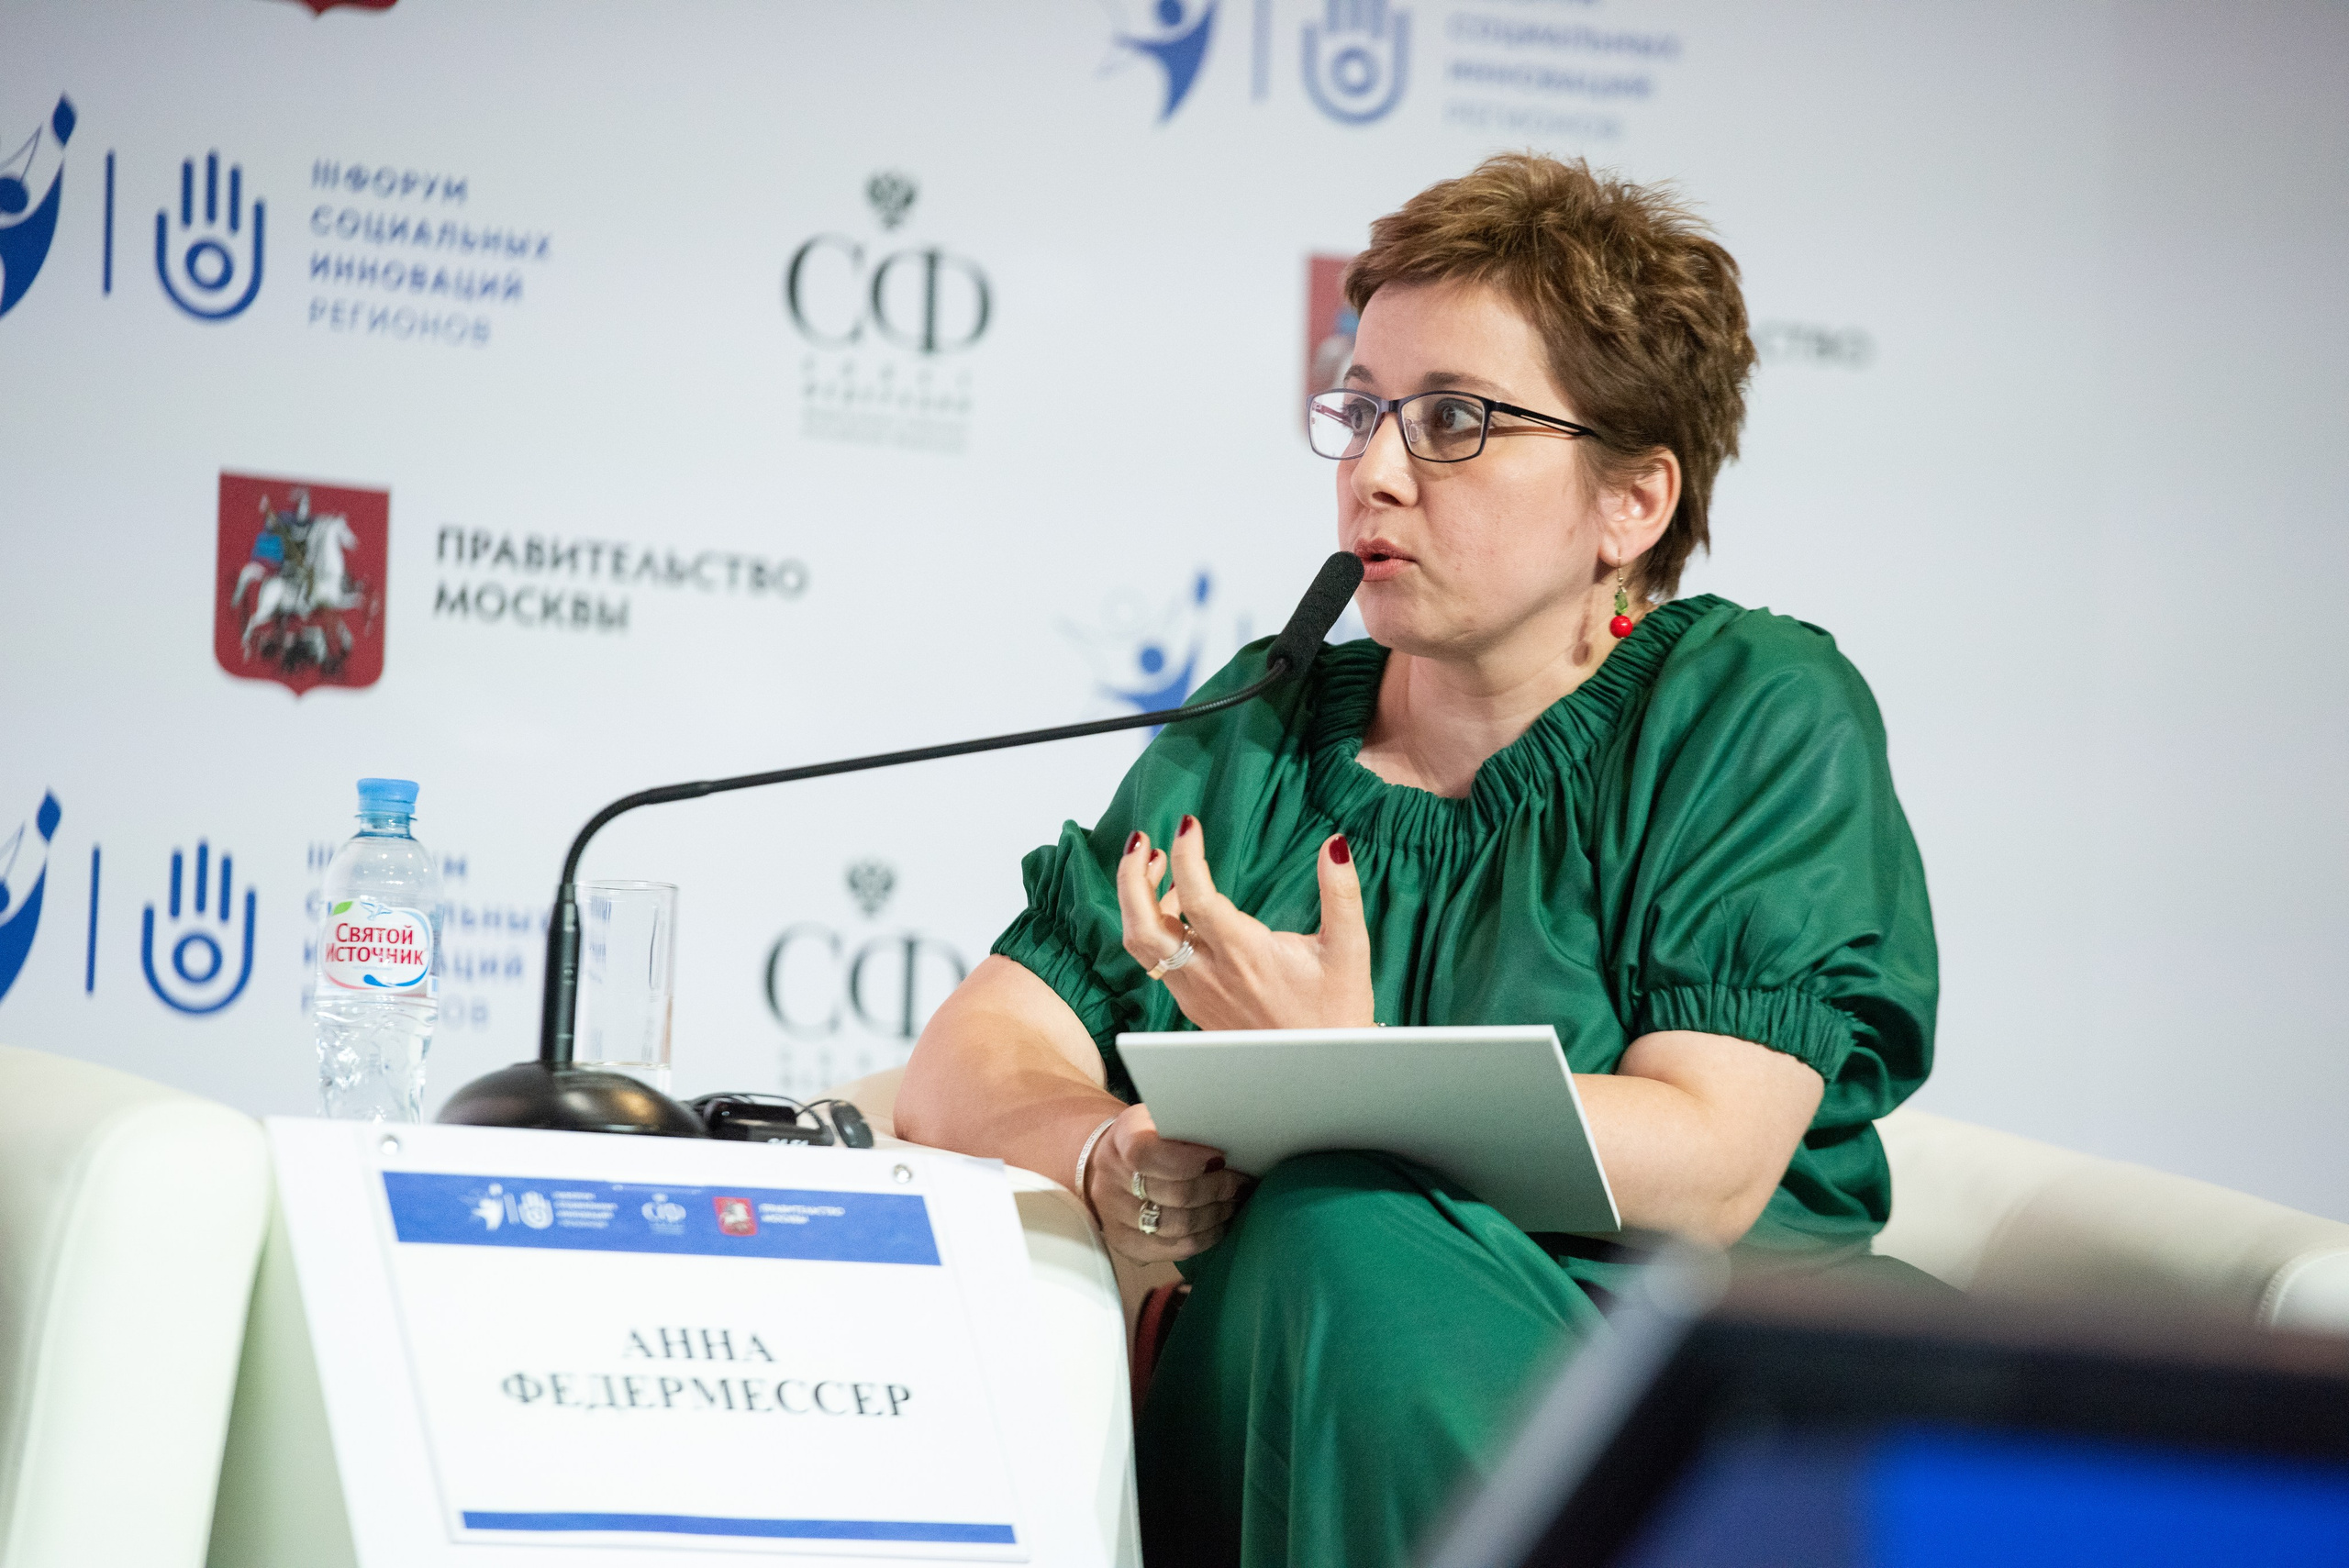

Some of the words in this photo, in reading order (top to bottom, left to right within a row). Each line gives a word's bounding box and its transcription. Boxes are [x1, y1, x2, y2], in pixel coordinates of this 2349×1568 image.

[310, 204, 551, 262] СОЦИАЛЬНЫХ
[310, 251, 523, 306] ИННОВАЦИЙ
[785, 231, 994, 354] СФ
[307, 295, 491, 348] РЕГИОНОВ
[437, 525, 809, 601] ПРАВИТЕЛЬСТВО
[434, 580, 630, 632] МОСКВЫ
[623, 1327, 778, 1362] АННА
[500, 1372, 913, 1418] ФЕДЕРМЕССЕР
